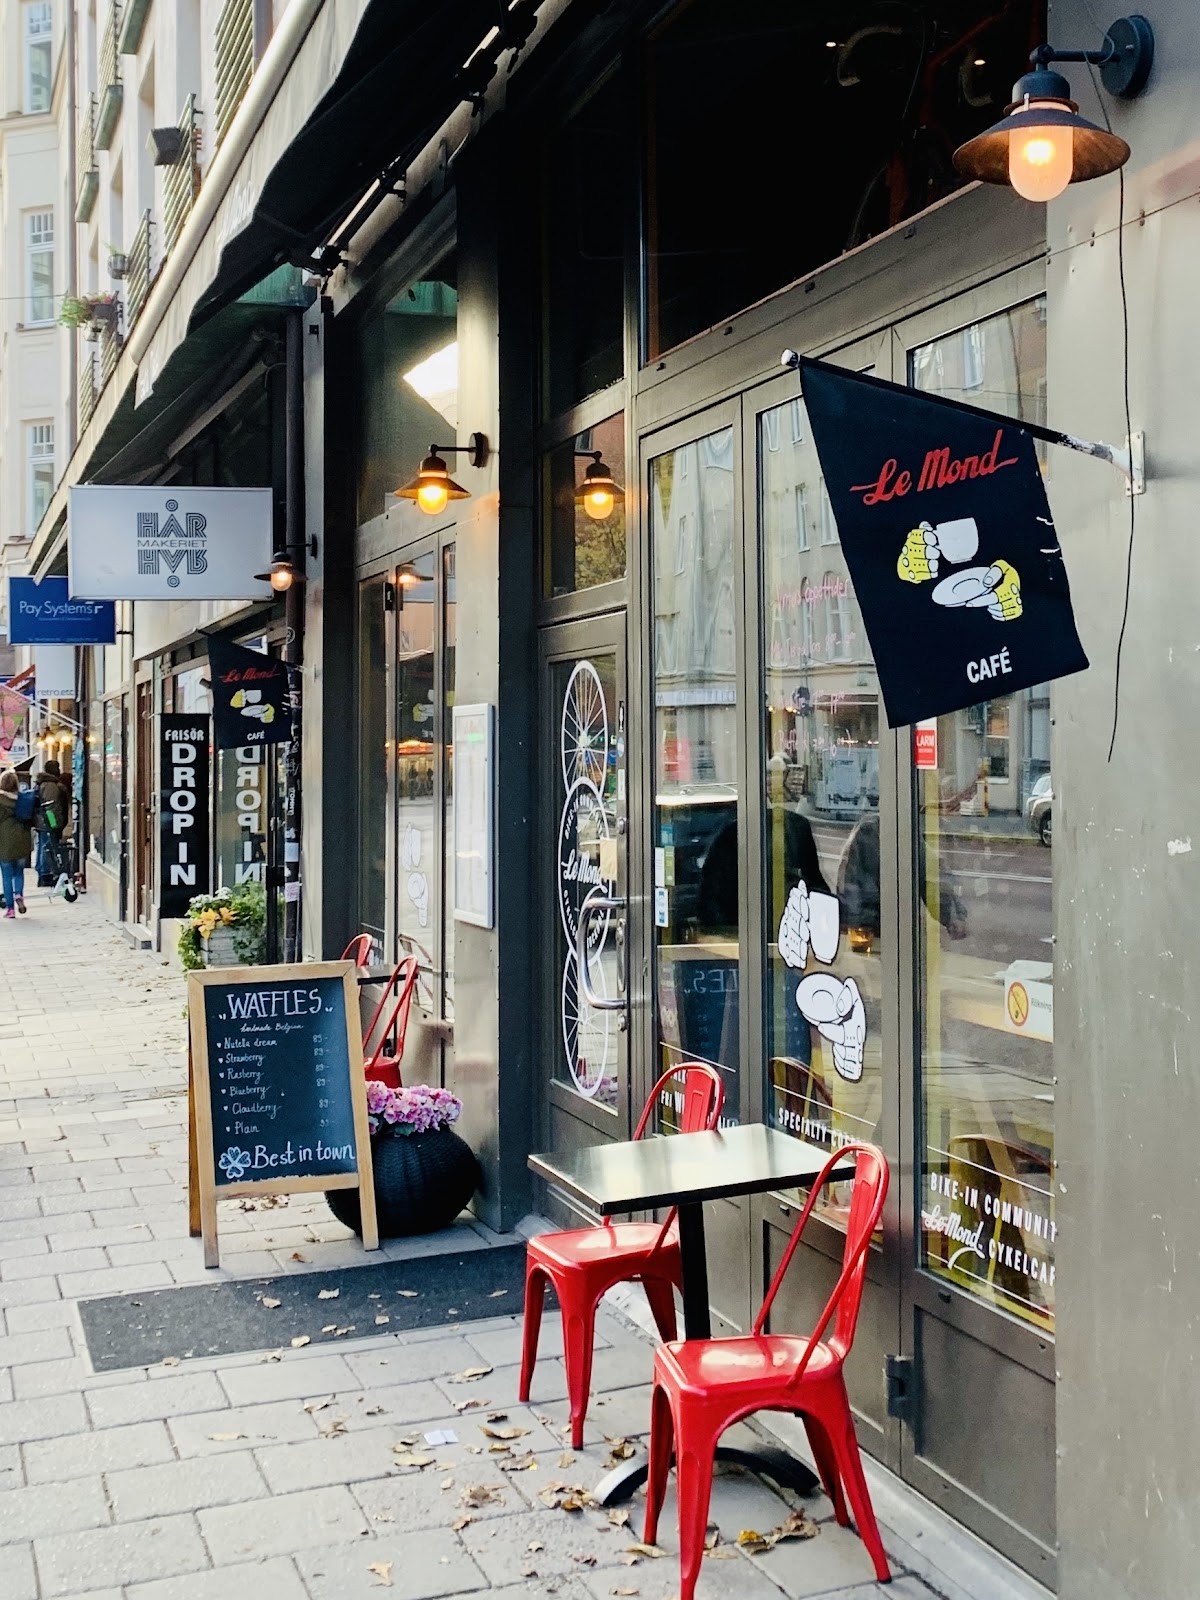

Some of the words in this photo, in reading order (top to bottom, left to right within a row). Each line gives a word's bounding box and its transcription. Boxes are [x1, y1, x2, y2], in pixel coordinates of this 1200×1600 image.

[850, 459, 911, 505] Le
[917, 429, 1018, 492] Mond
[137, 539, 207, 548] MAKERIET
[20, 600, 42, 617] Pay
[44, 600, 93, 617] Systems
[242, 664, 280, 681] Mond
[967, 647, 1012, 683] CAFÉ
[165, 729, 205, 742] FRISÖR
[247, 730, 265, 741] CAFÉ
[916, 734, 935, 747] LARM
[169, 743, 197, 835] DROP
[561, 848, 578, 880] Le
[226, 988, 322, 1019] WAFFLES
[224, 1037, 250, 1049] Nutella
[253, 1038, 277, 1047] dream
[660, 1089, 673, 1107] FRI
[232, 1102, 282, 1120] Cloudberry
[234, 1120, 260, 1135] Plain
[778, 1107, 827, 1143] SPECIALTY
[251, 1141, 296, 1168] Best
[299, 1145, 312, 1162] in
[315, 1140, 356, 1161] town
[930, 1171, 979, 1209] BIKE-IN
[944, 1212, 985, 1260] Mond
